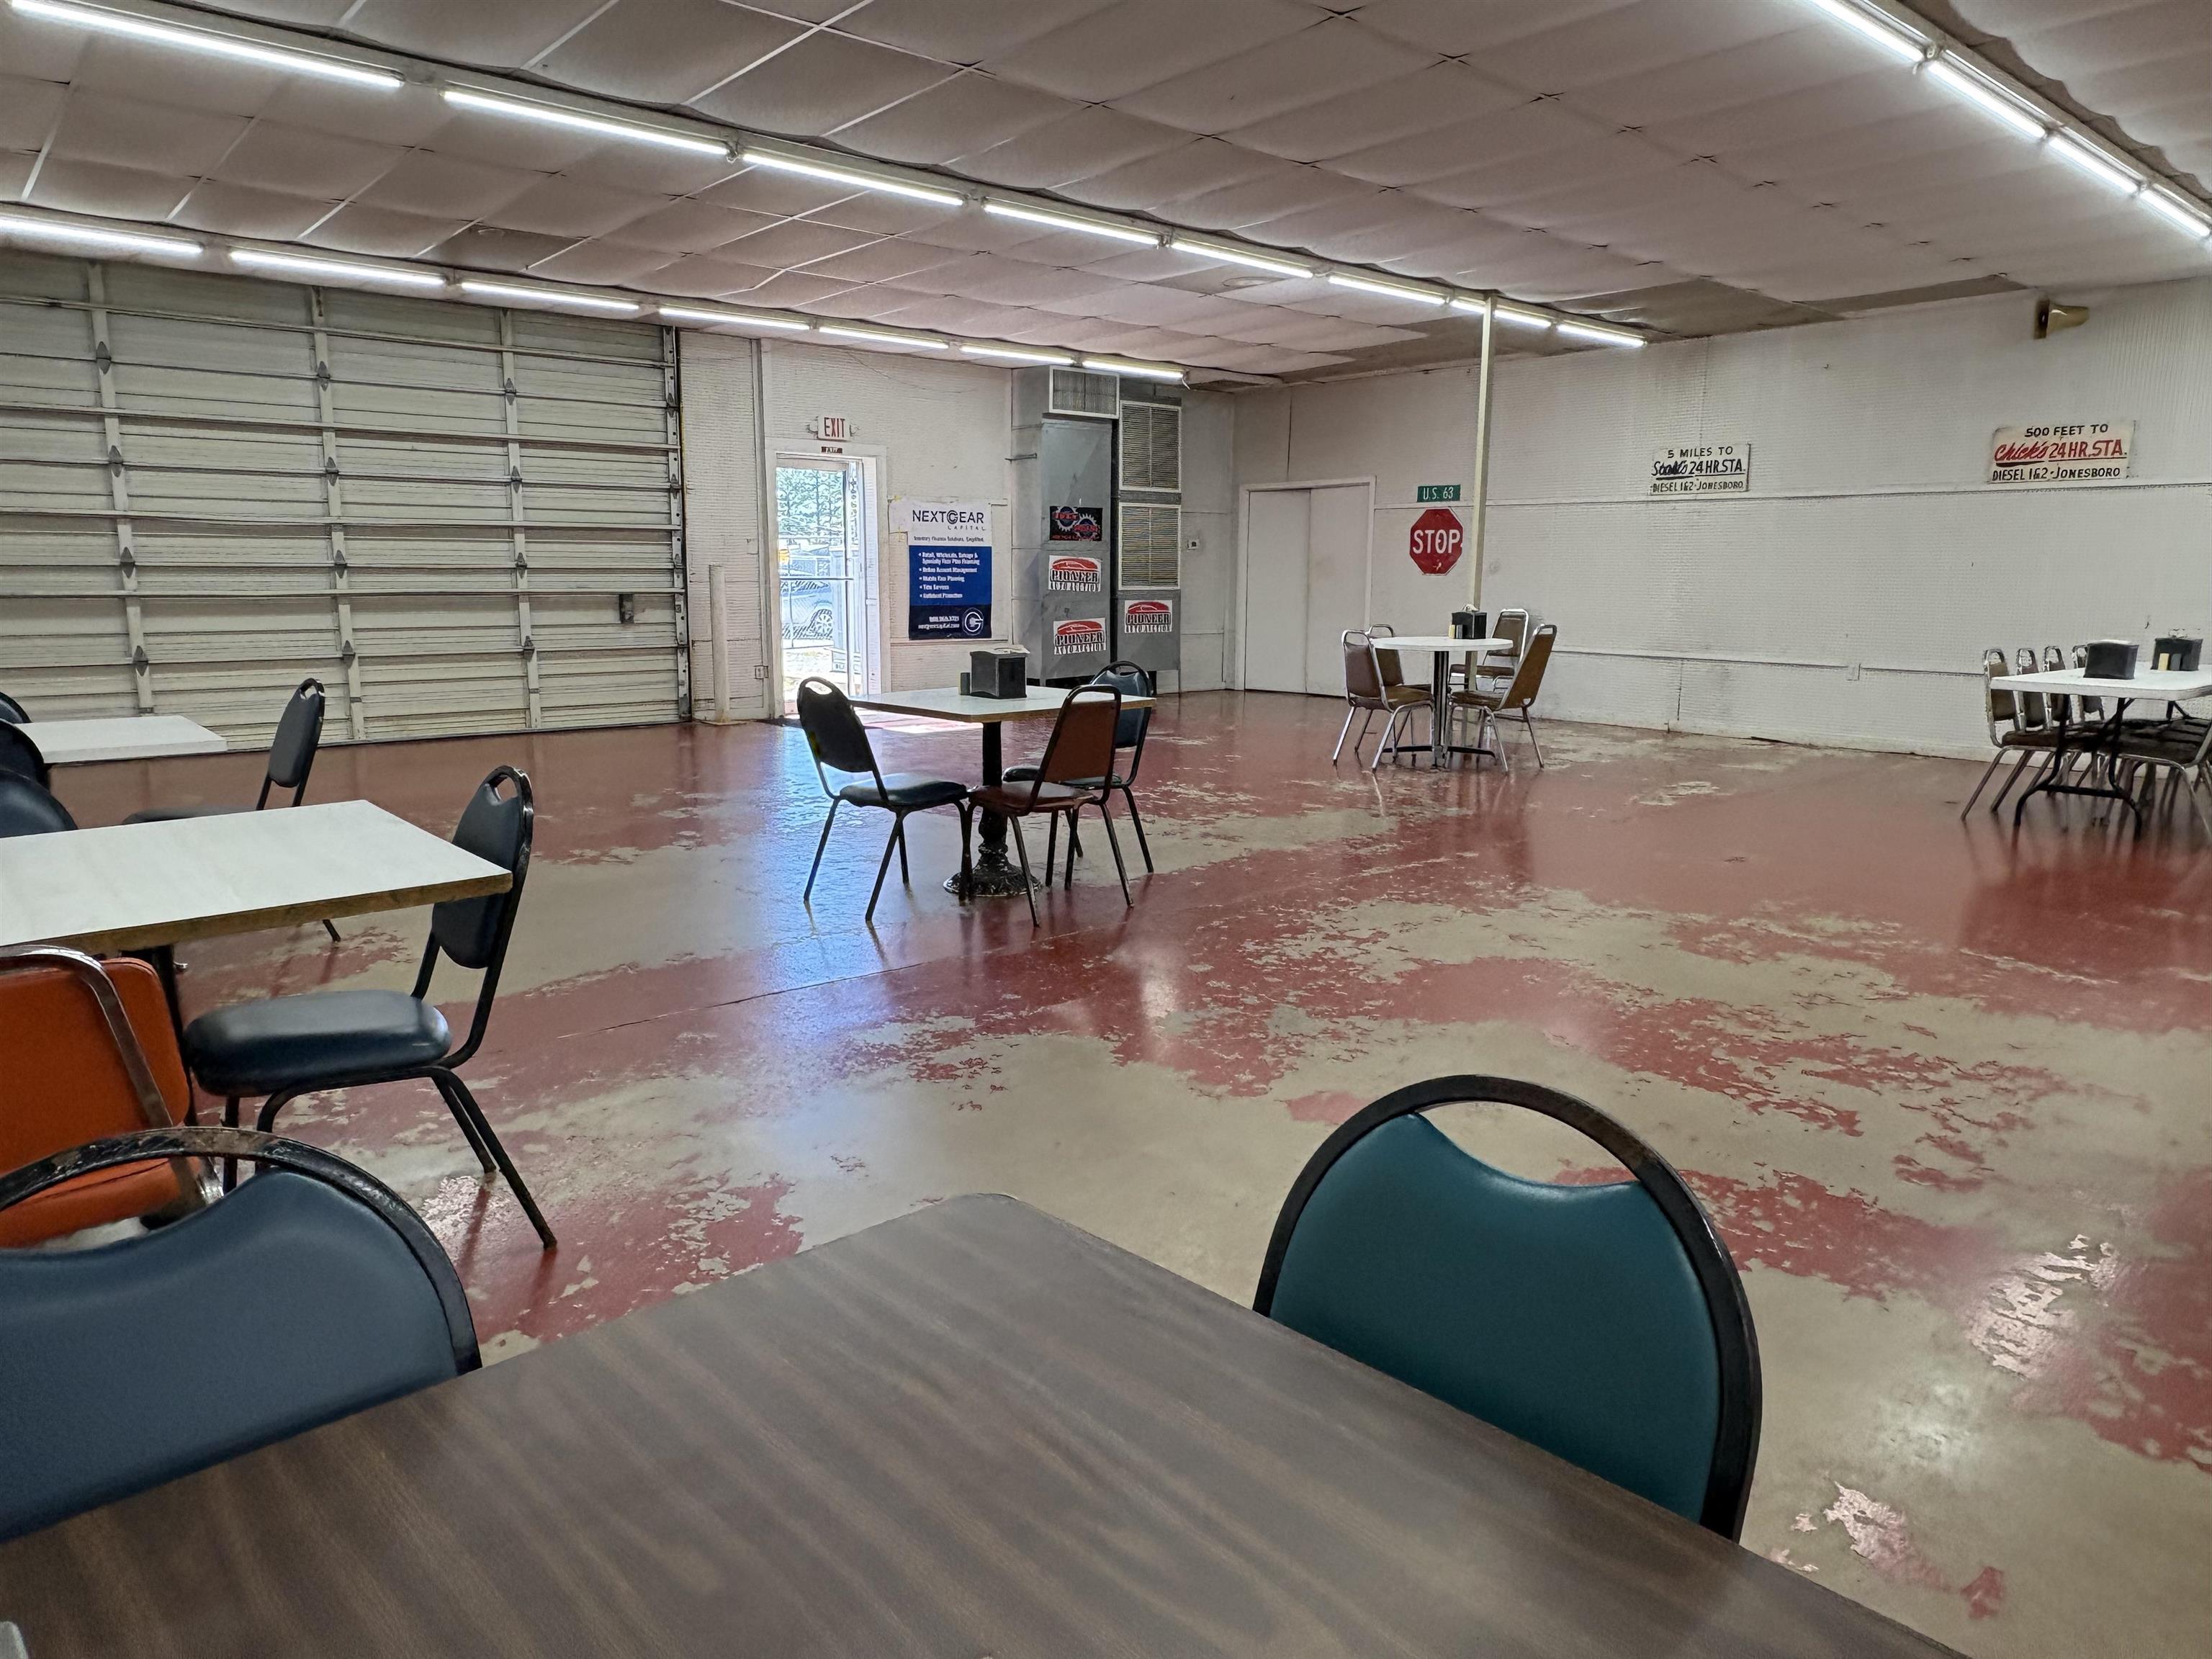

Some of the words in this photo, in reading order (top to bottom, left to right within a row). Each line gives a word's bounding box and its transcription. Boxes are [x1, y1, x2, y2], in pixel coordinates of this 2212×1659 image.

[824, 417, 845, 438] EXIT
[2025, 427, 2049, 438] 500
[2054, 426, 2085, 436] FEET
[2090, 423, 2108, 434] TO
[1680, 447, 1712, 457] MILES
[1719, 446, 1733, 455] TO
[1995, 441, 2048, 462] Chick's
[1992, 469, 2026, 481] DIESEL
[2052, 467, 2121, 479] JONESBORO
[1423, 487, 1439, 500] U.S.
[1443, 487, 1454, 499] 63
[1653, 482, 1678, 493] DIESEL
[1696, 480, 1744, 490] JONESBORO
[912, 510, 984, 524] NEXTGEAR
[1413, 529, 1461, 554] STOP
[1052, 570, 1098, 583] PIONEER
[1127, 613, 1169, 624] PIONEER
[1056, 631, 1104, 645] PIONEER
